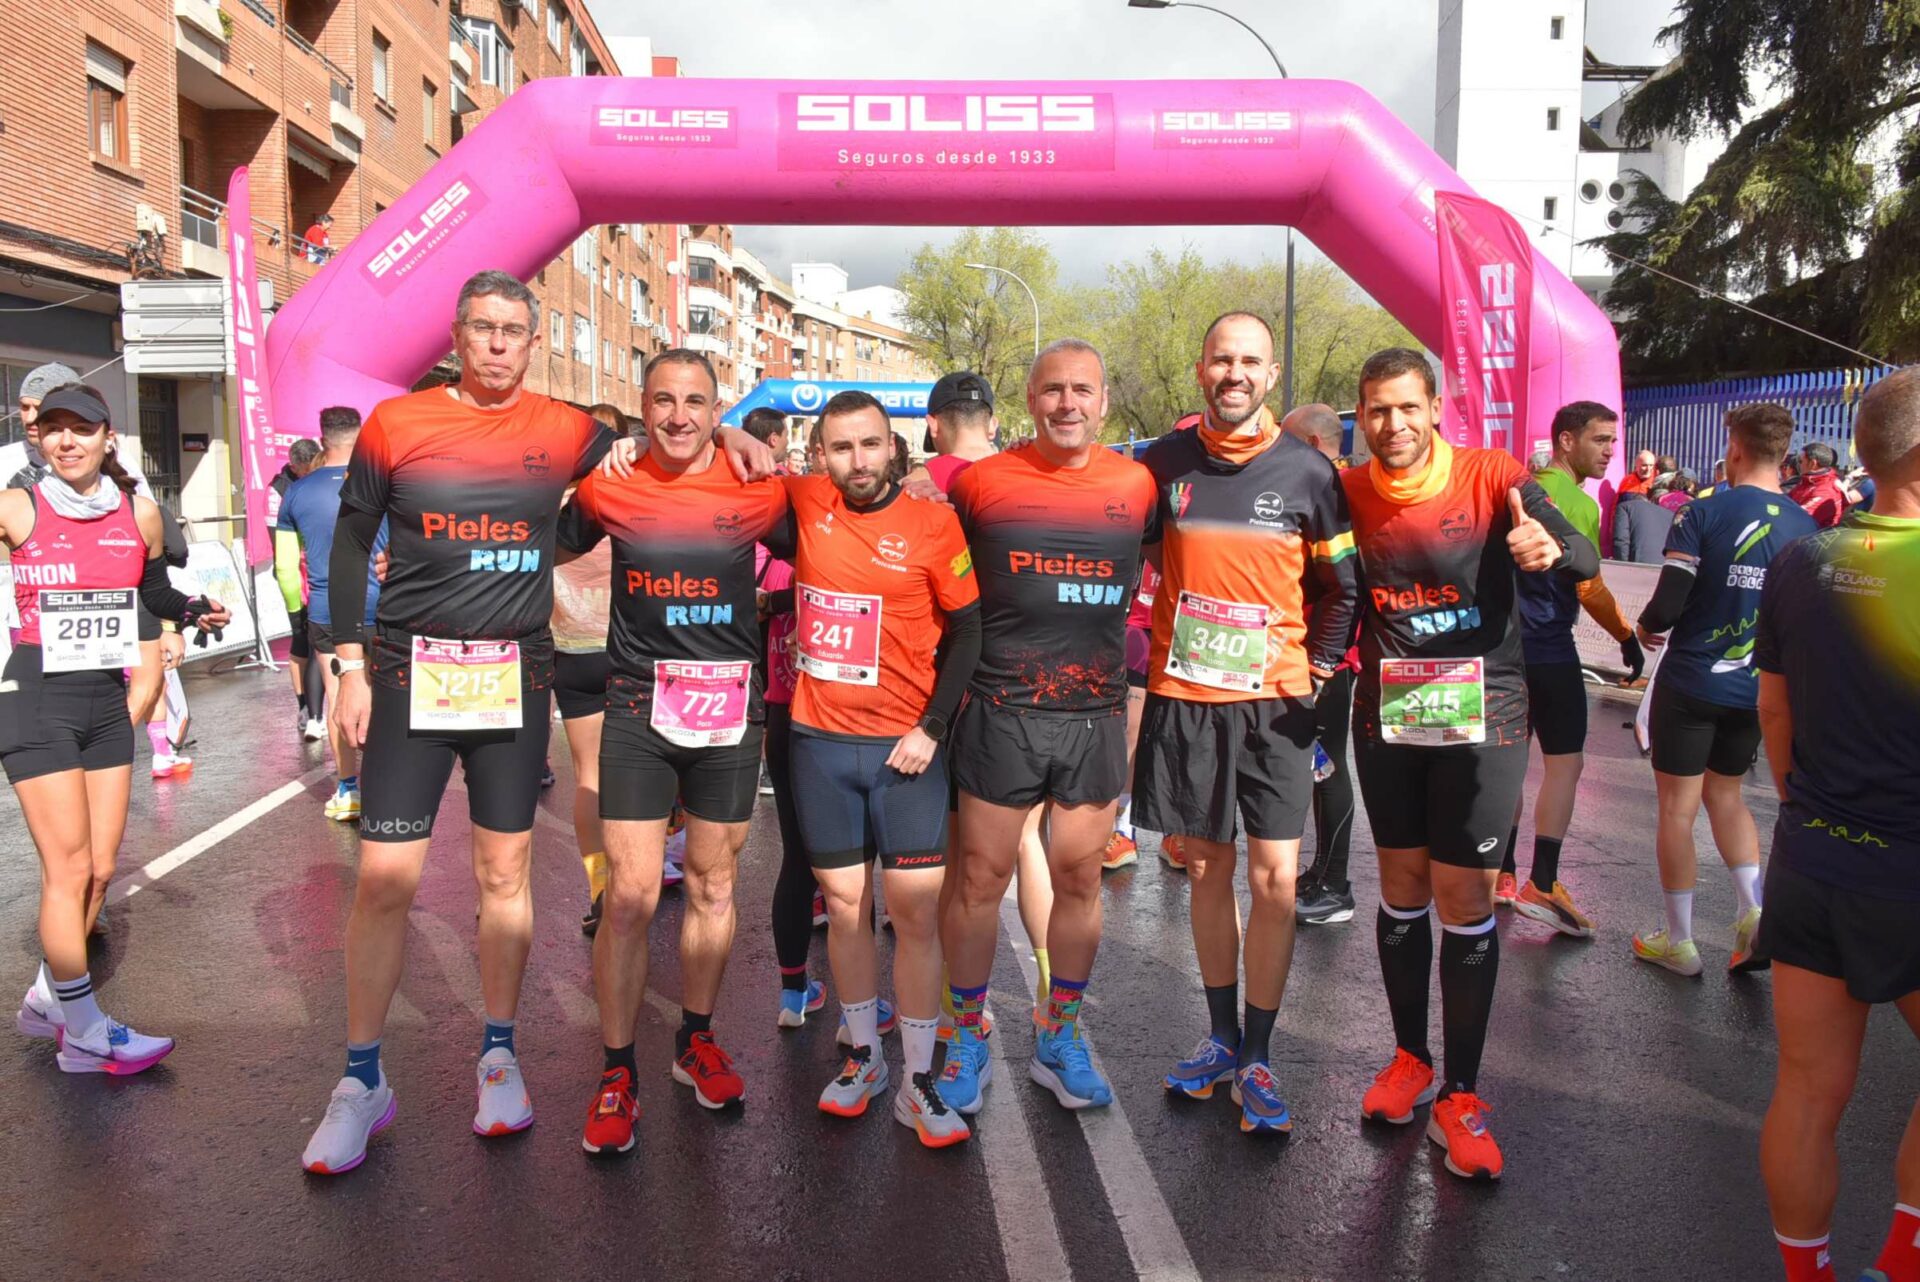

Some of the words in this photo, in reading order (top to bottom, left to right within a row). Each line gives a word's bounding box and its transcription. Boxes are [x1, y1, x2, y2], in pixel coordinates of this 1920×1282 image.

[599, 108, 729, 128] SOLISS
[797, 95, 1095, 131] SOLISS
[1162, 111, 1291, 130] SOLISS
[616, 133, 655, 143] Seguros
[658, 134, 686, 142] desde
[690, 135, 712, 143] 1933
[1180, 136, 1218, 145] Seguros
[1222, 136, 1249, 144] desde
[1253, 136, 1274, 144] 1933
[838, 149, 925, 166] Seguros
[936, 150, 997, 164] desde
[1009, 150, 1056, 164] 1933
[367, 180, 471, 278] SOLISS
[421, 512, 530, 542] Pieles
[470, 549, 540, 572] RUN
[1009, 551, 1115, 578] Pieles
[626, 569, 719, 598] Pieles
[1058, 582, 1124, 605] RUN
[47, 592, 127, 606] SOLISS
[803, 589, 871, 613] SOLISS
[1187, 597, 1261, 622] SOLISS
[1371, 582, 1461, 613] Pieles
[666, 604, 732, 626] RUN
[1410, 606, 1481, 636] RUN
[58, 616, 121, 640] 2819
[810, 620, 854, 650] 241
[423, 643, 511, 657] SOLISS
[1191, 627, 1248, 658] 340
[665, 664, 744, 679] SOLISS
[1389, 663, 1474, 676] SOLISS
[438, 670, 501, 697] 1215
[681, 689, 728, 716] 772
